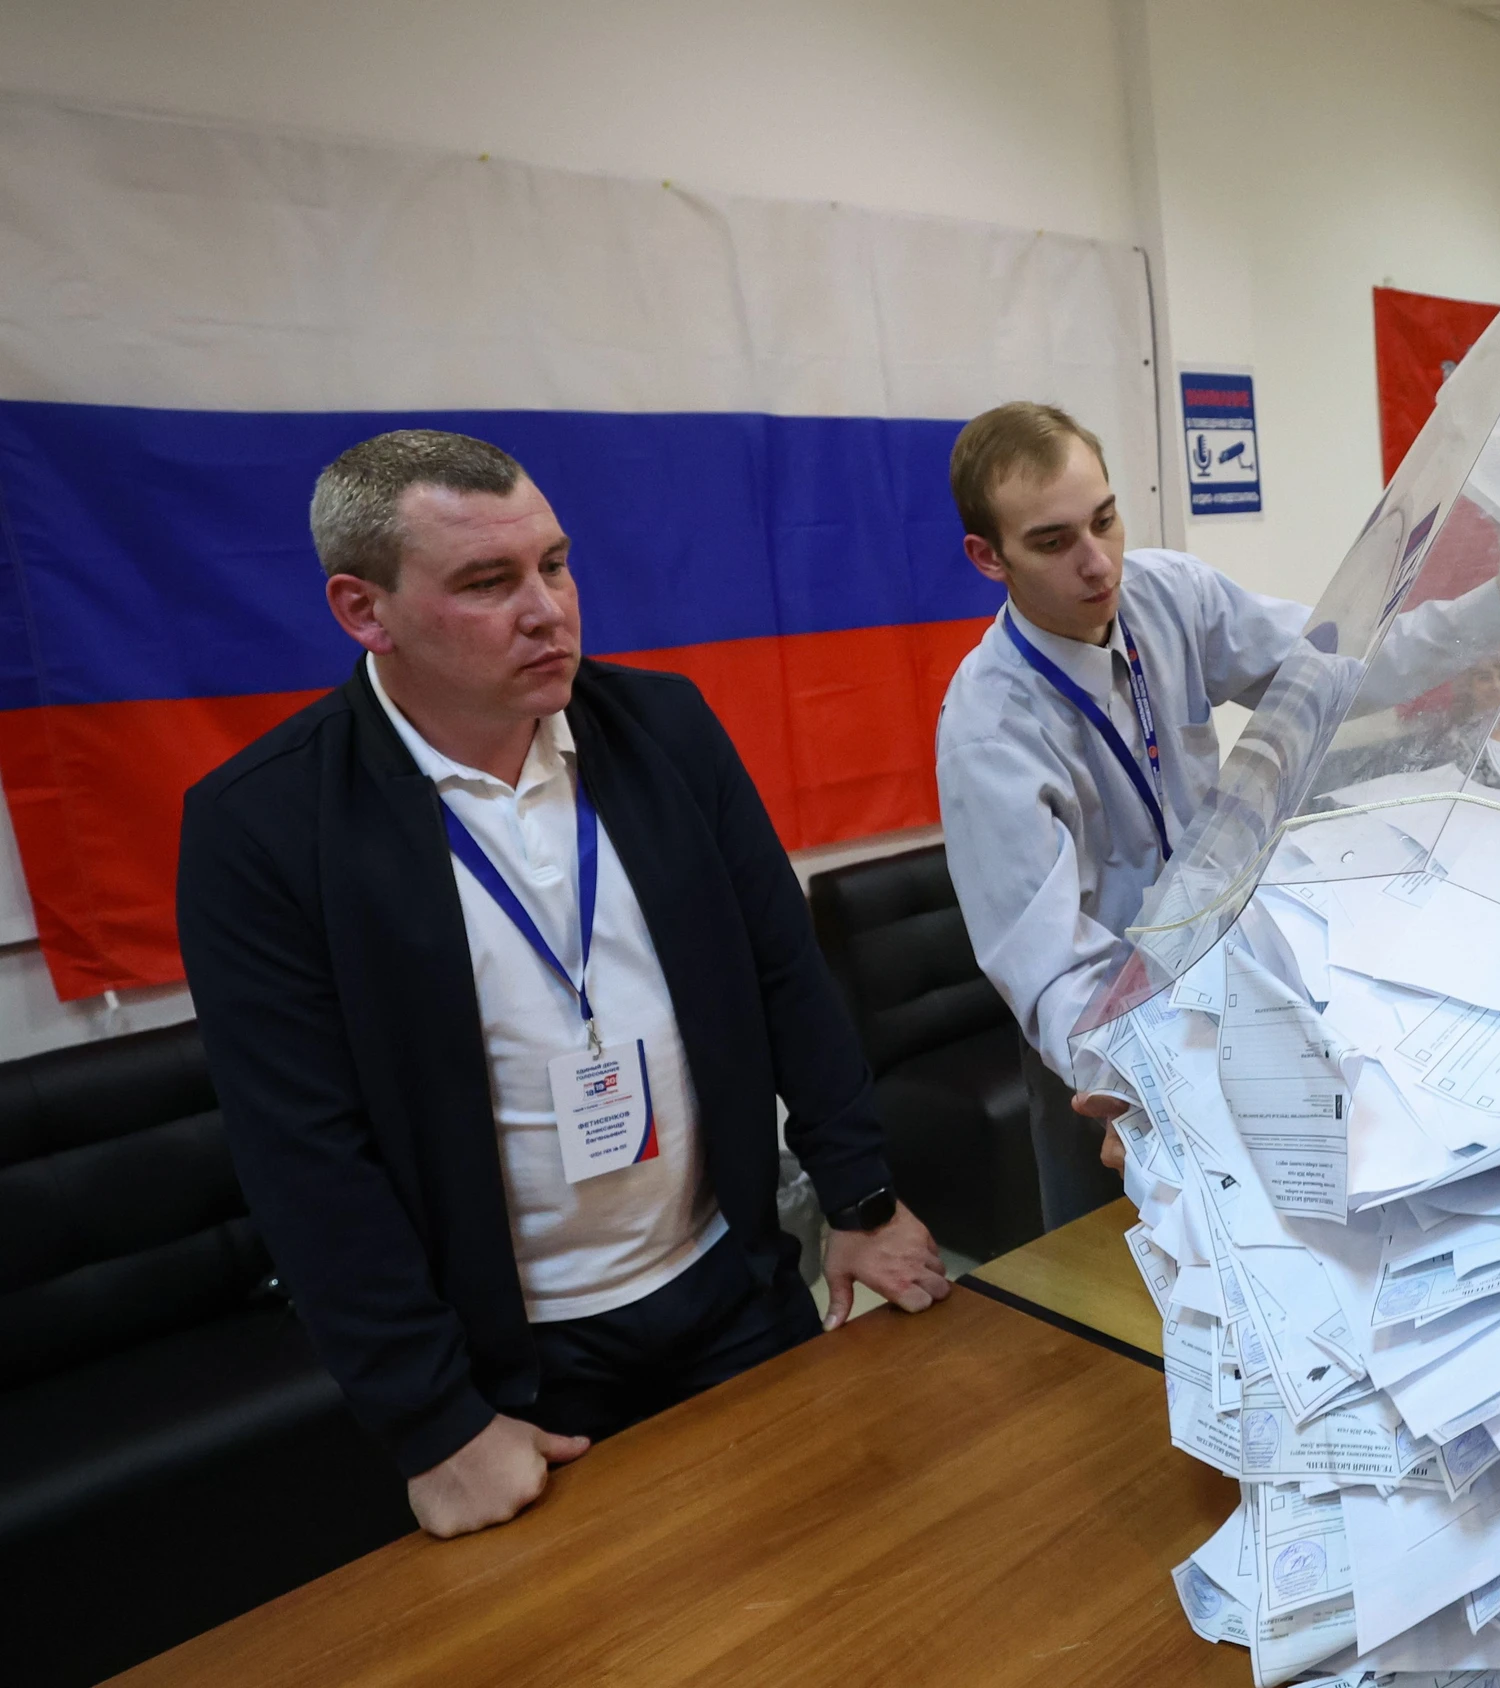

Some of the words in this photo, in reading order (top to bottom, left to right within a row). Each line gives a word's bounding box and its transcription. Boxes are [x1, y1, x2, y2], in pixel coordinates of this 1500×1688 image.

[604, 1076, 616, 1086] 20
[577, 1110, 630, 1131] ФЕТИСЕНКОВ
[584, 1121, 625, 1137] Александр
[585, 1129, 627, 1145] Евгеньевич
